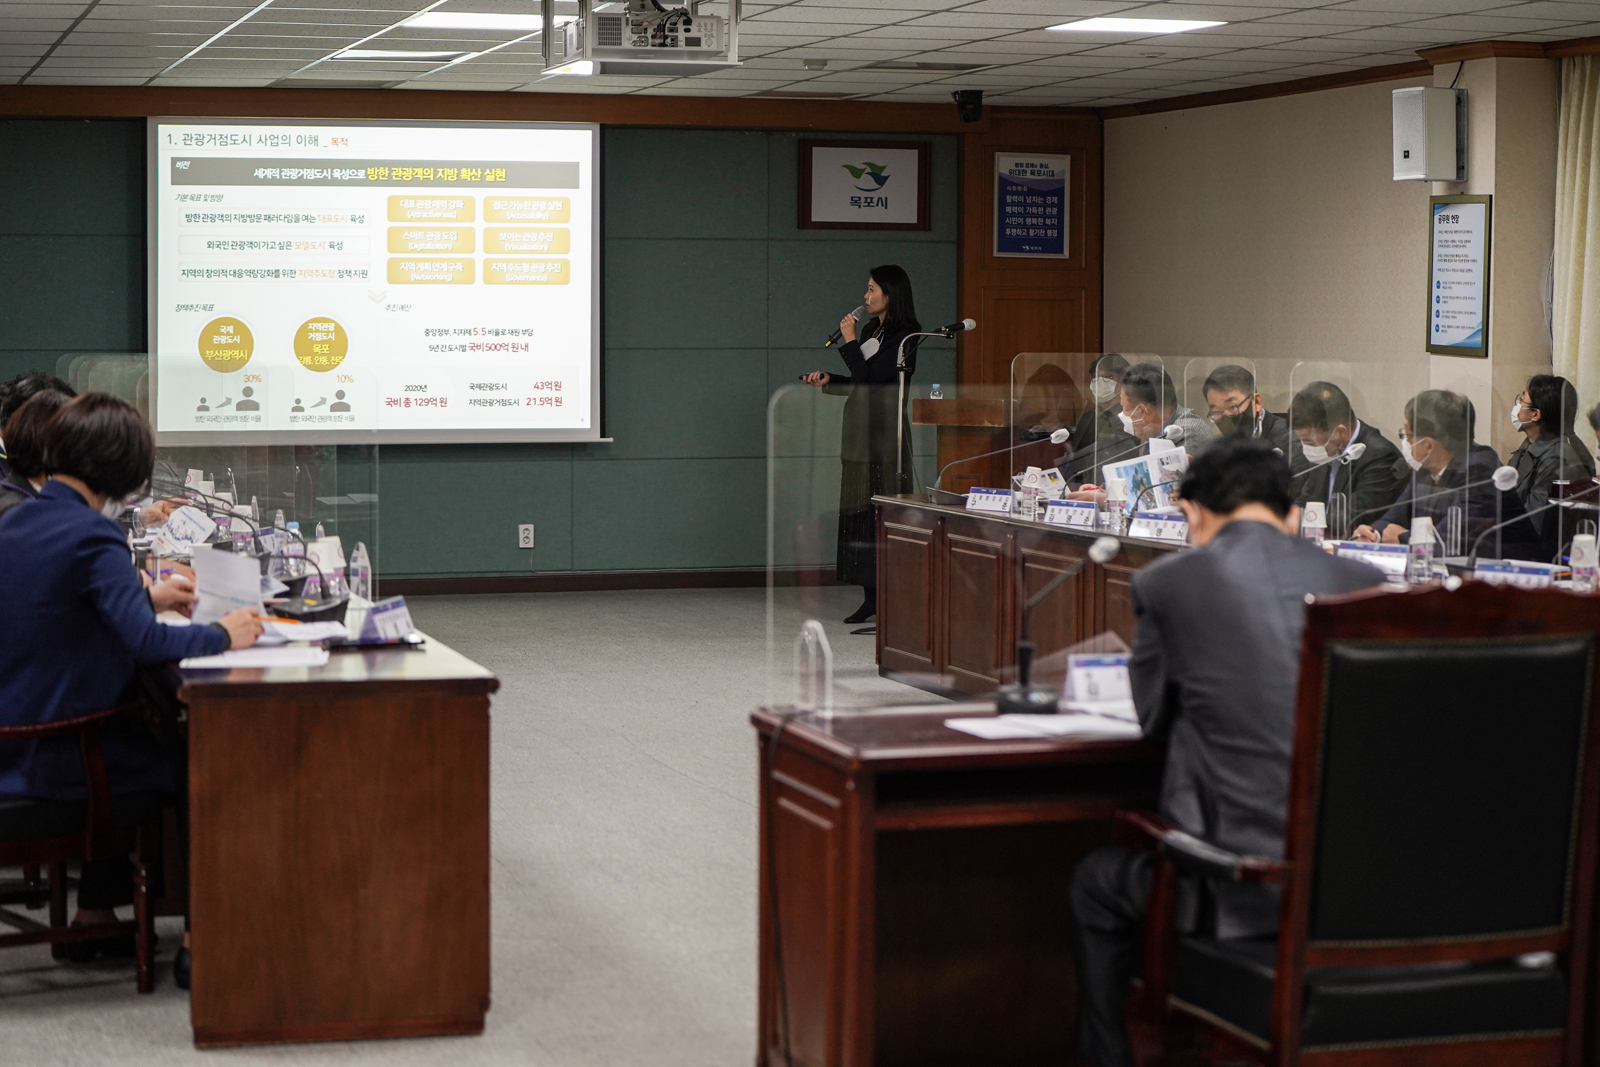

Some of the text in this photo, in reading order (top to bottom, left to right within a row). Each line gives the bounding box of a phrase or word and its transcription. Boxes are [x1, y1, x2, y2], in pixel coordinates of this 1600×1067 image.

[167, 133, 178, 146] 1.
[182, 133, 252, 146] 관광거점도시
[256, 134, 292, 147] 사업의
[296, 134, 319, 148] 이해
[330, 137, 348, 148] 목적
[175, 160, 191, 170] 비전
[253, 166, 506, 182] 세계적 관광거점도시 육성으로 방한 관광객의 지방 확산 실현
[1030, 169, 1055, 177] 목포시대
[400, 199, 464, 209] 대표 관광 매력 강화
[850, 196, 888, 210] 목포시
[1006, 195, 1024, 203] 활력이
[532, 200, 546, 210] 관광
[548, 201, 562, 211] 실현
[185, 213, 200, 223] 방한
[201, 213, 232, 223] 관광객의
[263, 214, 300, 223] 패러다임을
[301, 214, 316, 223] 여는
[350, 214, 365, 224] 육성
[1438, 214, 1450, 224] 공무원
[402, 231, 457, 240] 스마트 관광 도입
[522, 232, 538, 242] 관광
[538, 232, 553, 242] 추진
[1005, 228, 1028, 236] 투명하고
[206, 241, 230, 250] 외국인
[230, 241, 261, 250] 관광객이
[261, 241, 277, 250] 가고
[278, 241, 293, 250] 싶은
[328, 241, 343, 251] 육성
[400, 262, 415, 272] 지역
[530, 263, 546, 272] 관광
[546, 263, 561, 273] 추진
[181, 268, 205, 278] 지역의
[205, 269, 228, 278] 창의적
[281, 269, 296, 279] 위한
[337, 269, 352, 279] 정책
[353, 269, 368, 279] 지원
[219, 325, 234, 334] 국제
[308, 322, 336, 332] 지역관광
[308, 332, 335, 341] 거점도시
[424, 328, 452, 337] 중앙정부,
[452, 328, 472, 336] 지자체
[488, 328, 507, 337] 비율로
[507, 328, 520, 336] 재원
[521, 328, 534, 337] 부담
[212, 335, 240, 344] 관광도시
[312, 344, 330, 354] 목포
[468, 342, 484, 352] 국비
[205, 350, 248, 360] 부산광역시
[243, 374, 262, 383] 30%
[336, 374, 354, 383] 10%
[404, 384, 428, 392] 2020년
[468, 383, 508, 391] 국제관광도시
[385, 397, 401, 408] 국비
[403, 397, 412, 408] 총
[414, 397, 438, 408] 129억
[468, 398, 520, 407] 지역관광거점도시
